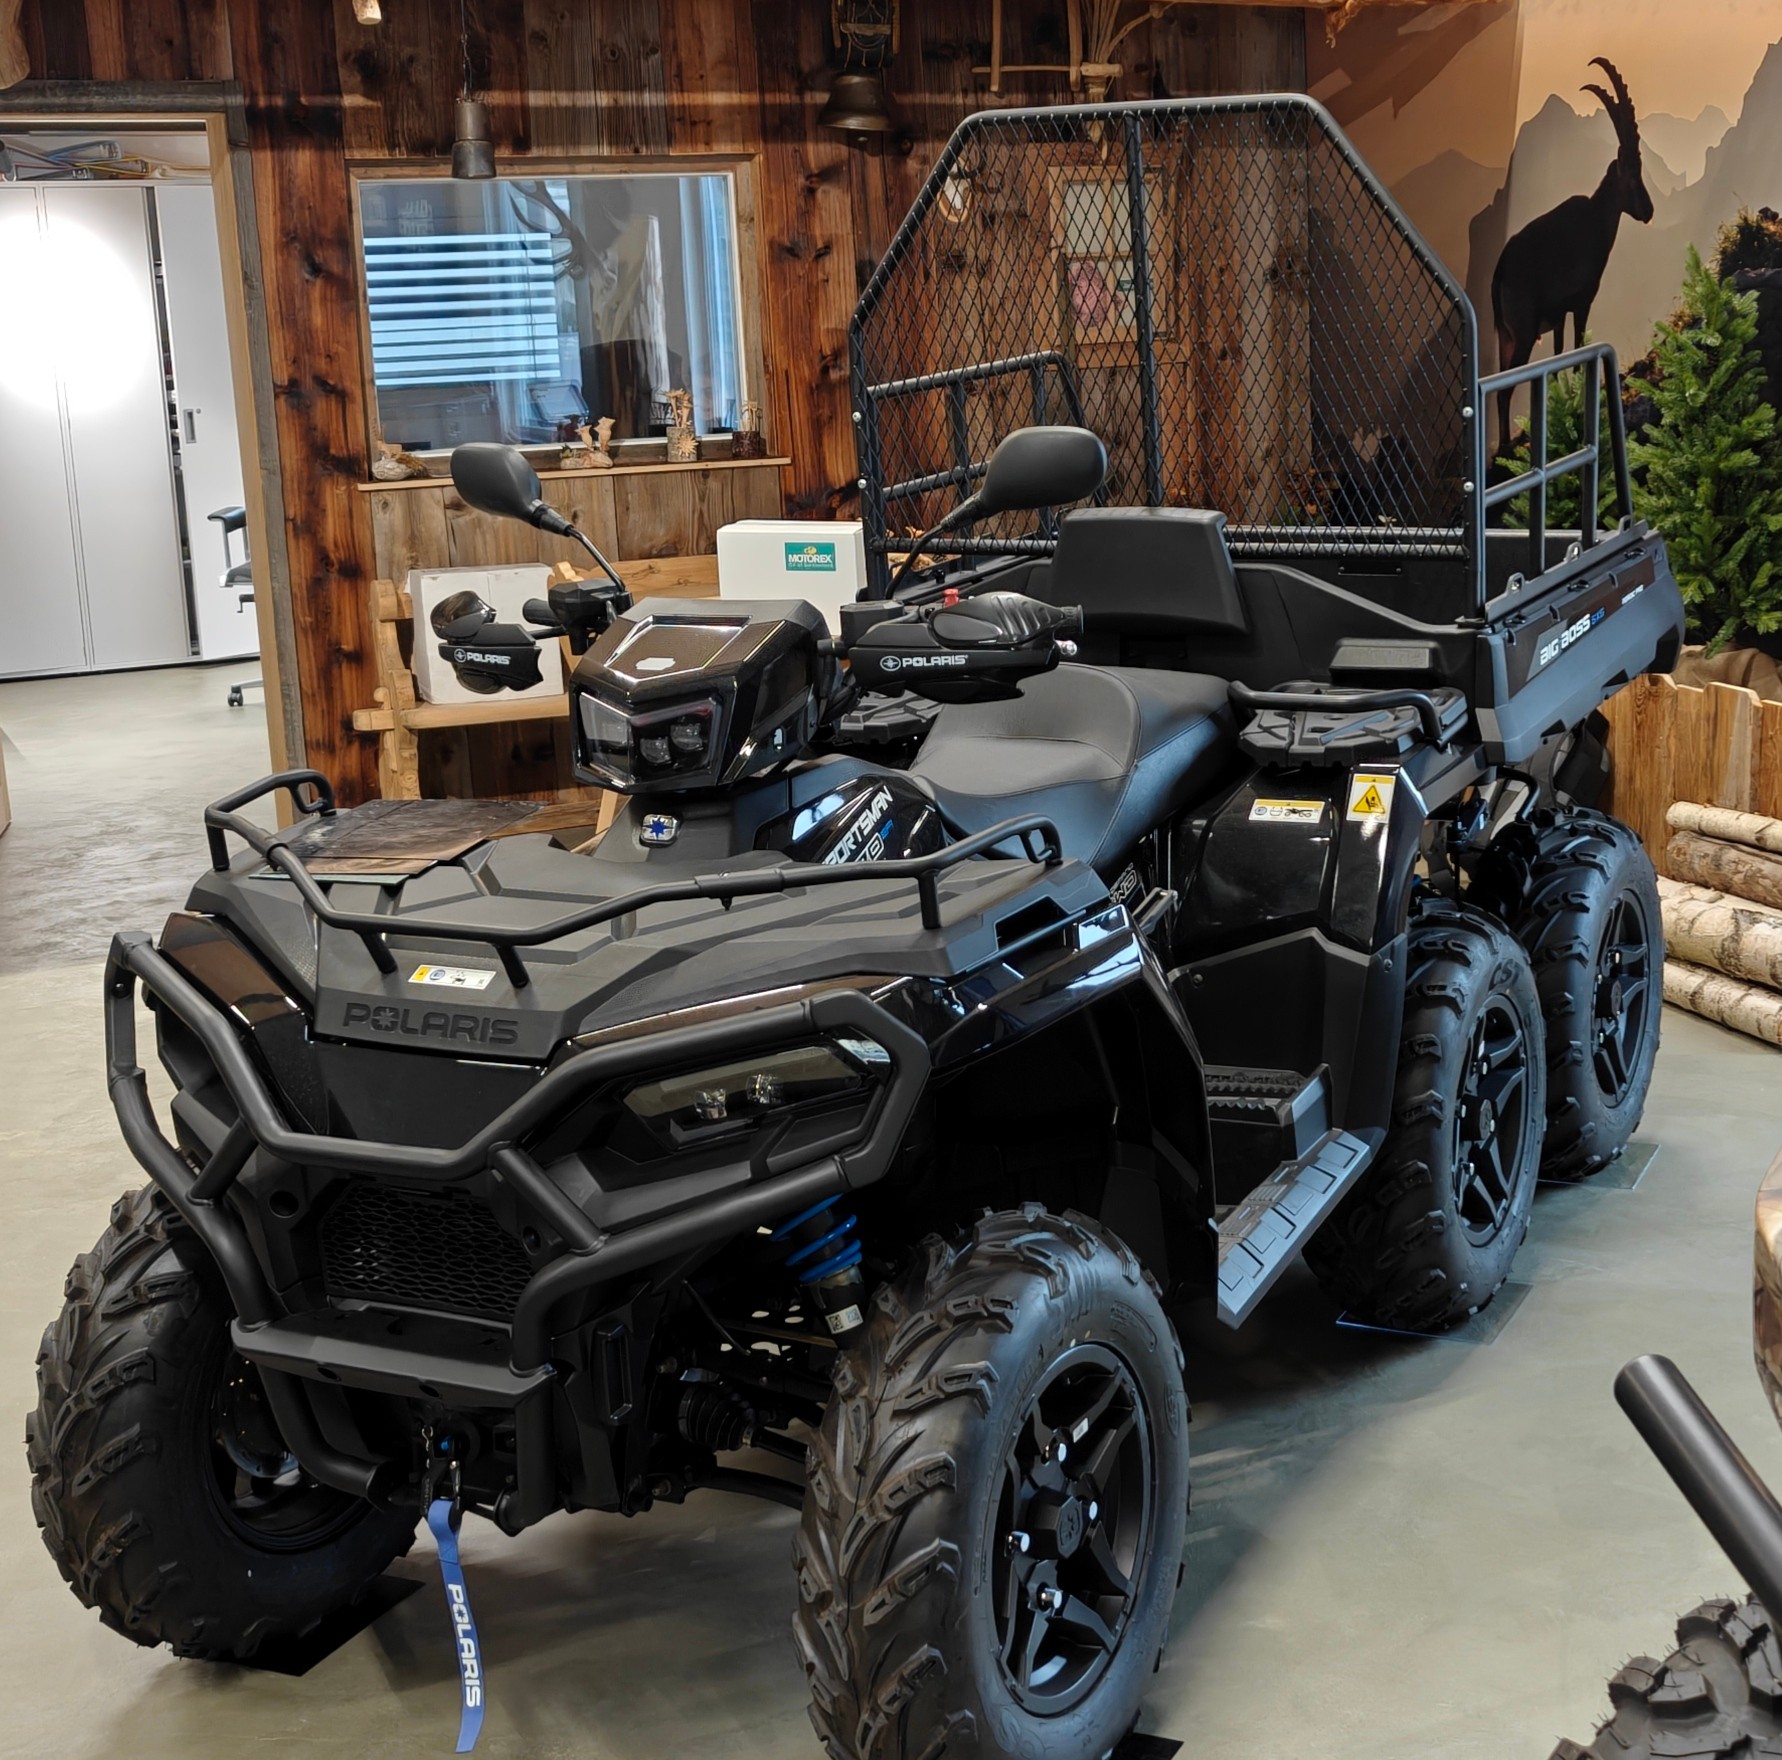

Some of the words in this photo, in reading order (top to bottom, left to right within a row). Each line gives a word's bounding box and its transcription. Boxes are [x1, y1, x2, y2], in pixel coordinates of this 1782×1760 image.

[788, 554, 832, 563] MOTOREX
[466, 651, 511, 665] POLARIS
[1540, 638, 1560, 666] BIG
[1561, 613, 1591, 650] BOSS
[901, 654, 968, 668] POLARIS
[822, 785, 893, 865] PORTSMAN
[1488, 958, 1525, 992] CST
[342, 1002, 519, 1045] POLARIS
[448, 1583, 481, 1708] POLARIS
